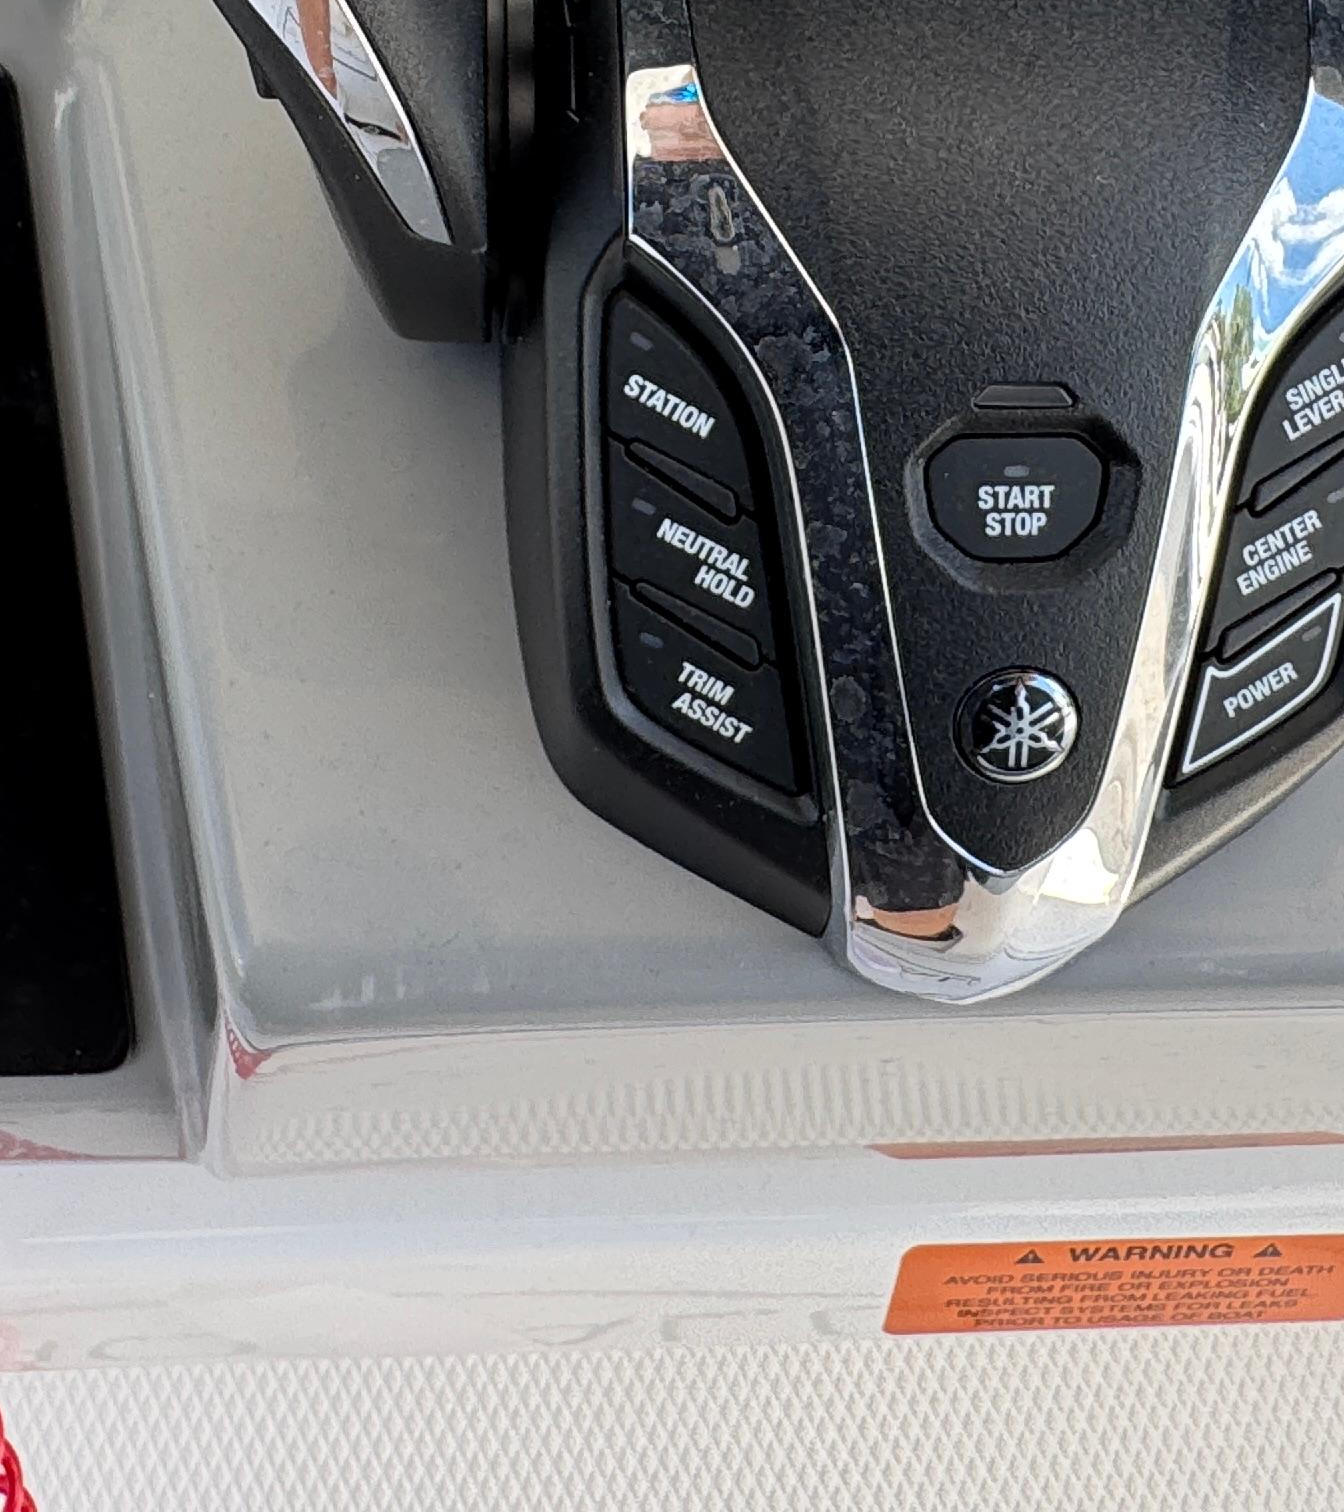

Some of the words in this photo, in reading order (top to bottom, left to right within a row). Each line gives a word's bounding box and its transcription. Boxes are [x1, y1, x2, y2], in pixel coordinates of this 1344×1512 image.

[623, 374, 716, 440] STATION
[977, 485, 1055, 510] START
[984, 512, 1048, 537] STOP
[1242, 510, 1323, 567] CENTER
[656, 518, 750, 583] NEUTRAL
[1236, 544, 1313, 597] ENGINE
[694, 564, 755, 609] HOLD
[677, 660, 735, 707] TRIM
[1223, 662, 1299, 719] POWER
[671, 692, 753, 745] ASSIST
[942, 1273, 1015, 1285] AVOID
[1020, 1270, 1124, 1283] SERIOUS
[1130, 1266, 1213, 1280] INJURY
[1217, 1266, 1252, 1278] OR
[1257, 1263, 1336, 1277] DEATH
[1068, 1244, 1234, 1263] WARNING
[986, 1284, 1054, 1295] FROM
[1059, 1282, 1112, 1293] FIRE
[1117, 1281, 1152, 1292] OR
[1158, 1277, 1290, 1291] EXPLOSION
[1080, 1292, 1147, 1304] FROM
[1256, 1287, 1311, 1299] FUEL
